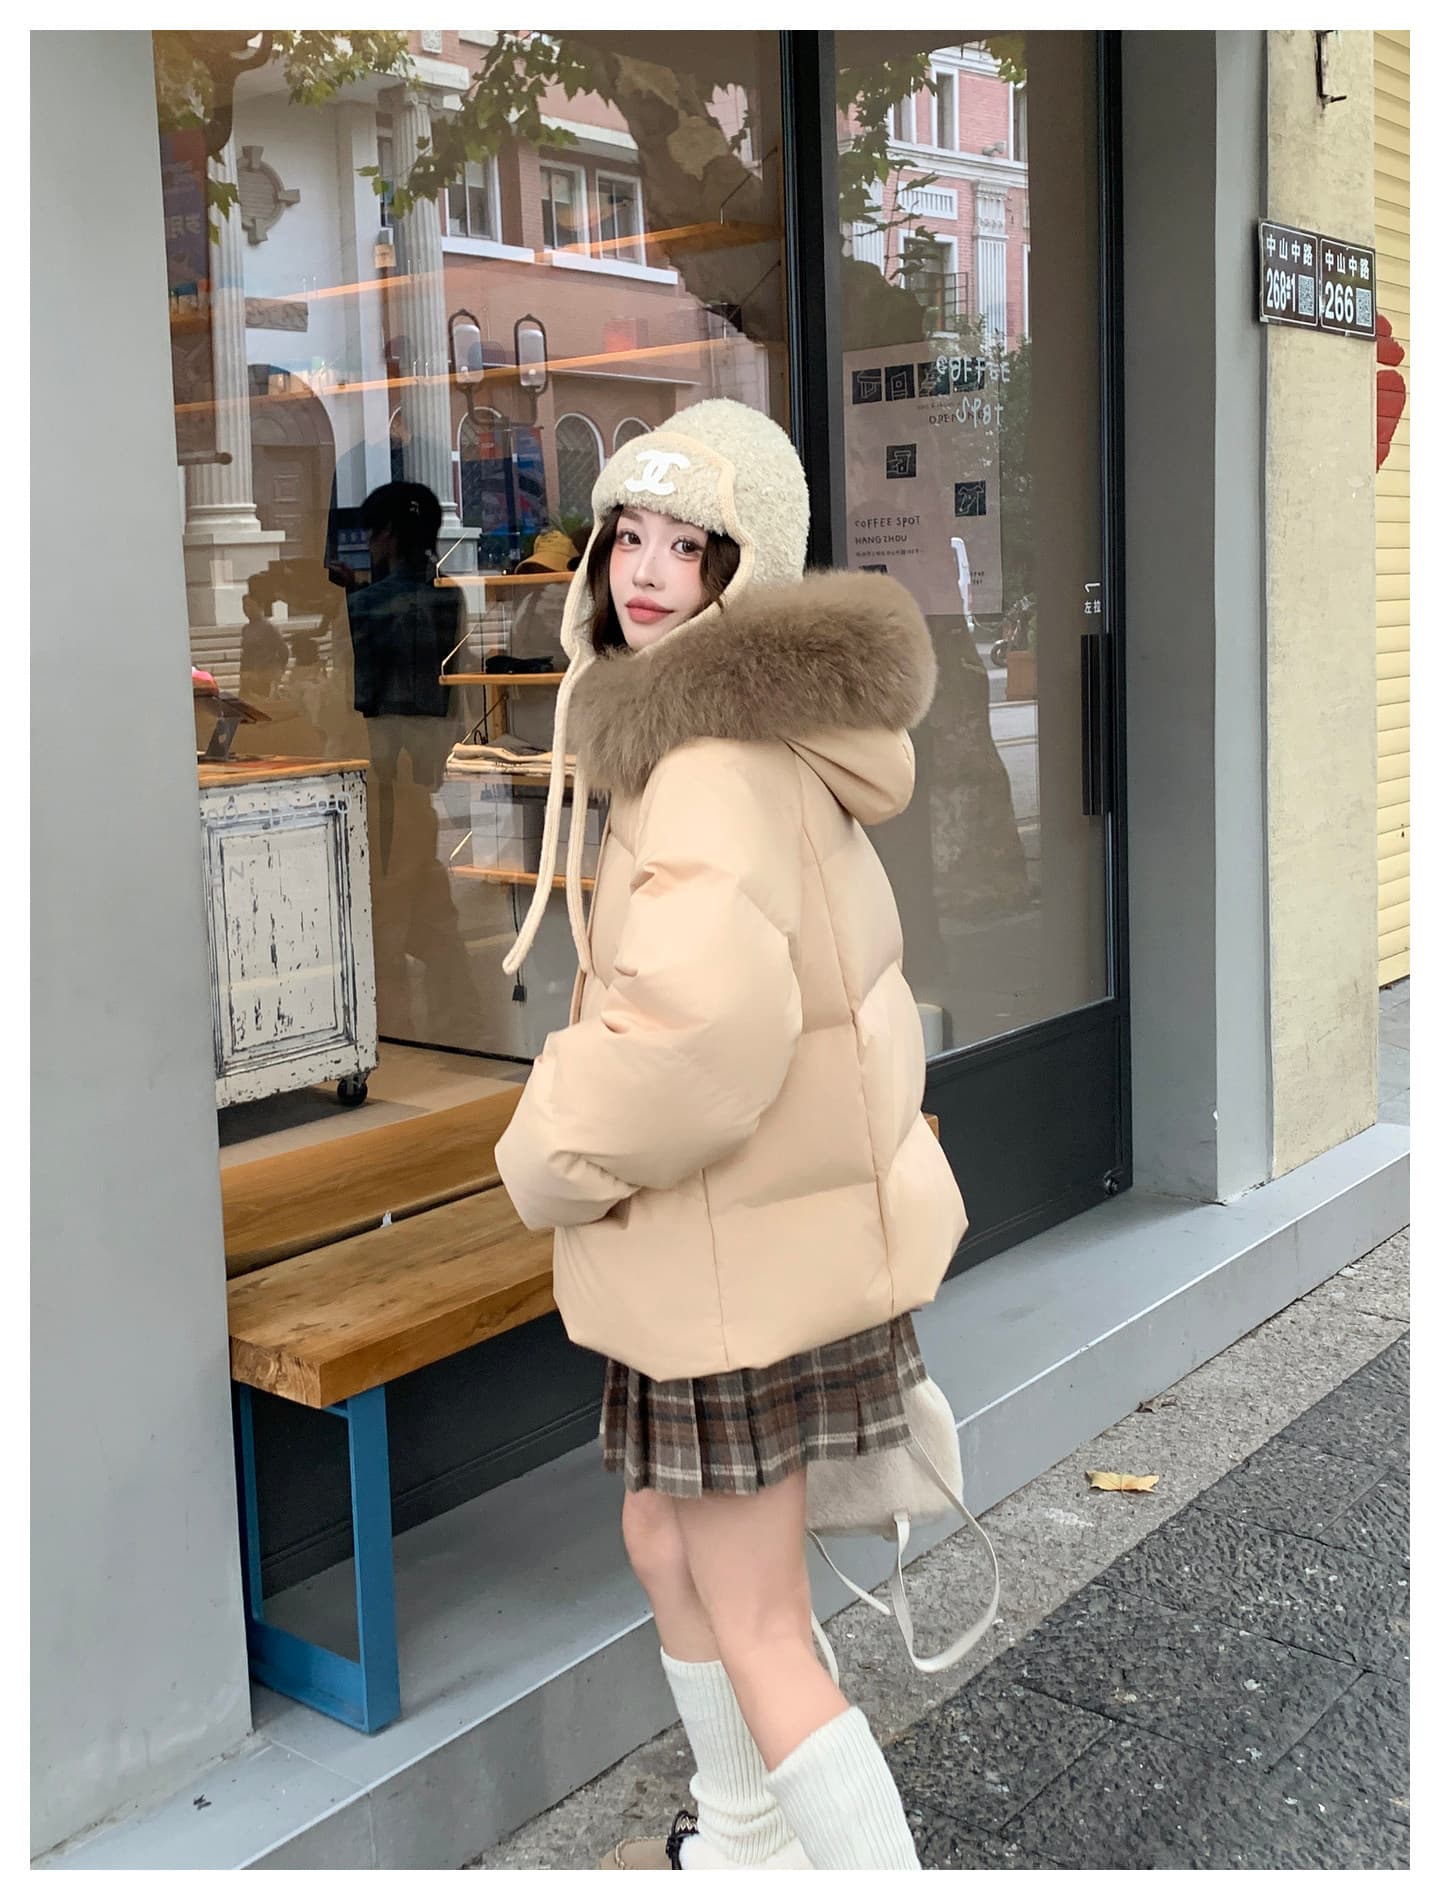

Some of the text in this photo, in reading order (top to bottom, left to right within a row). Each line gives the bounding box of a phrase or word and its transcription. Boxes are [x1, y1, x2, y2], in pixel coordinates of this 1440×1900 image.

[1266, 233, 1313, 267] 中山中路
[1325, 248, 1370, 280] 中山中路
[1324, 280, 1354, 324] 266
[854, 515, 921, 530] COFFEE SPOT
[854, 533, 908, 546] HANGZHOU
